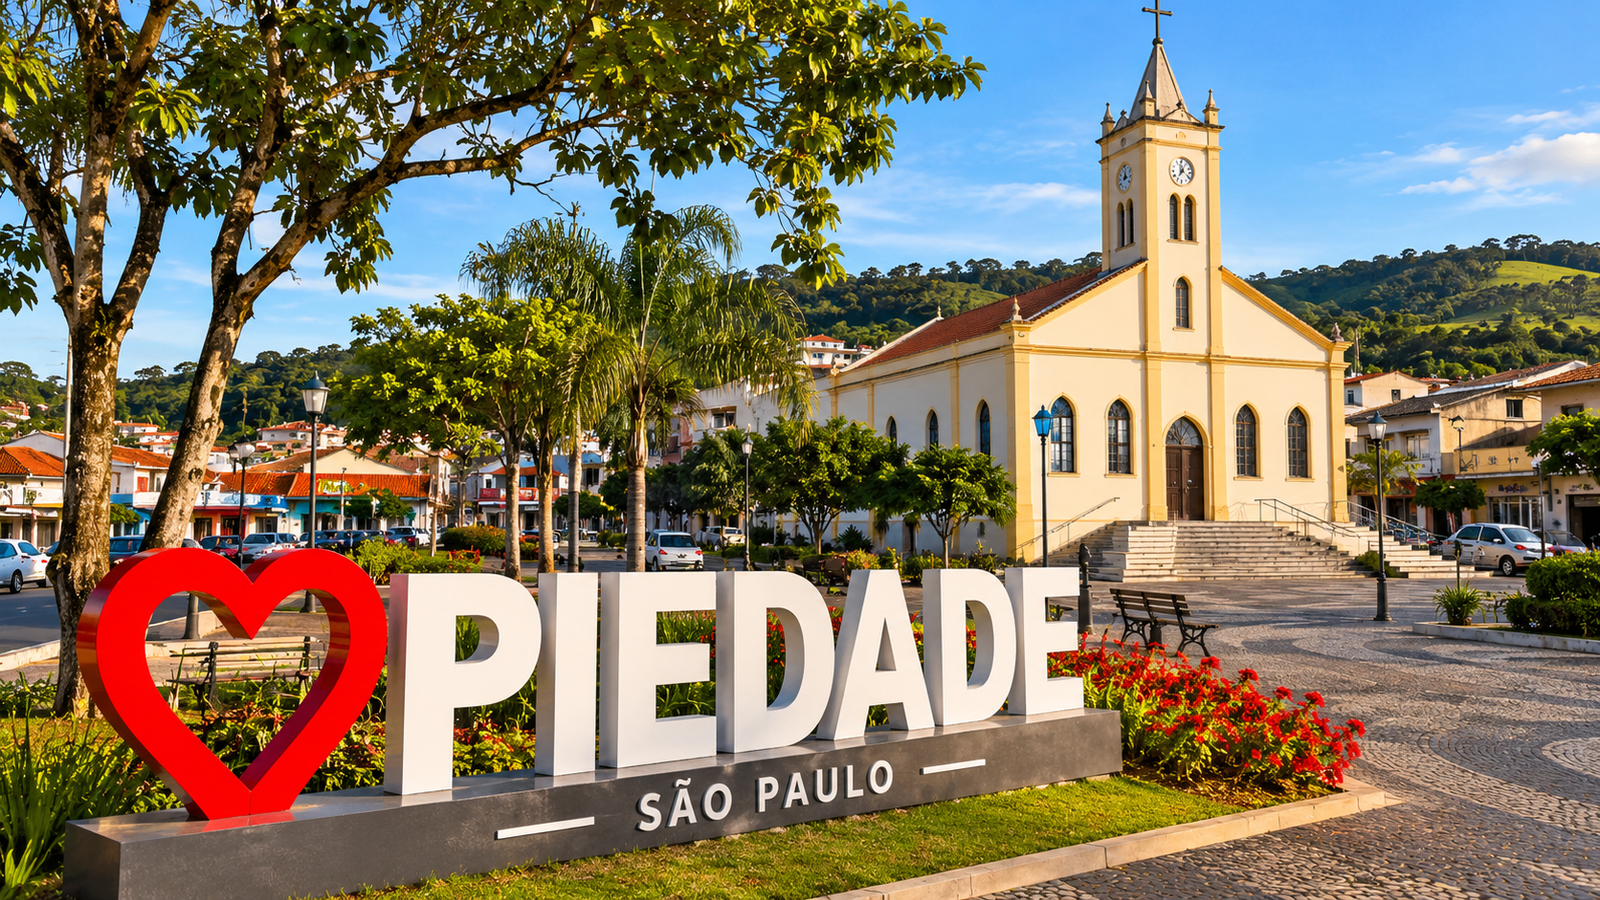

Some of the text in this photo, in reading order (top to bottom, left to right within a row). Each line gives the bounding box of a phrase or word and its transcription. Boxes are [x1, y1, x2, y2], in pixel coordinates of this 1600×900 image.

[384, 566, 1084, 796] PIEDADE
[636, 759, 894, 832] SÃO PAULO
